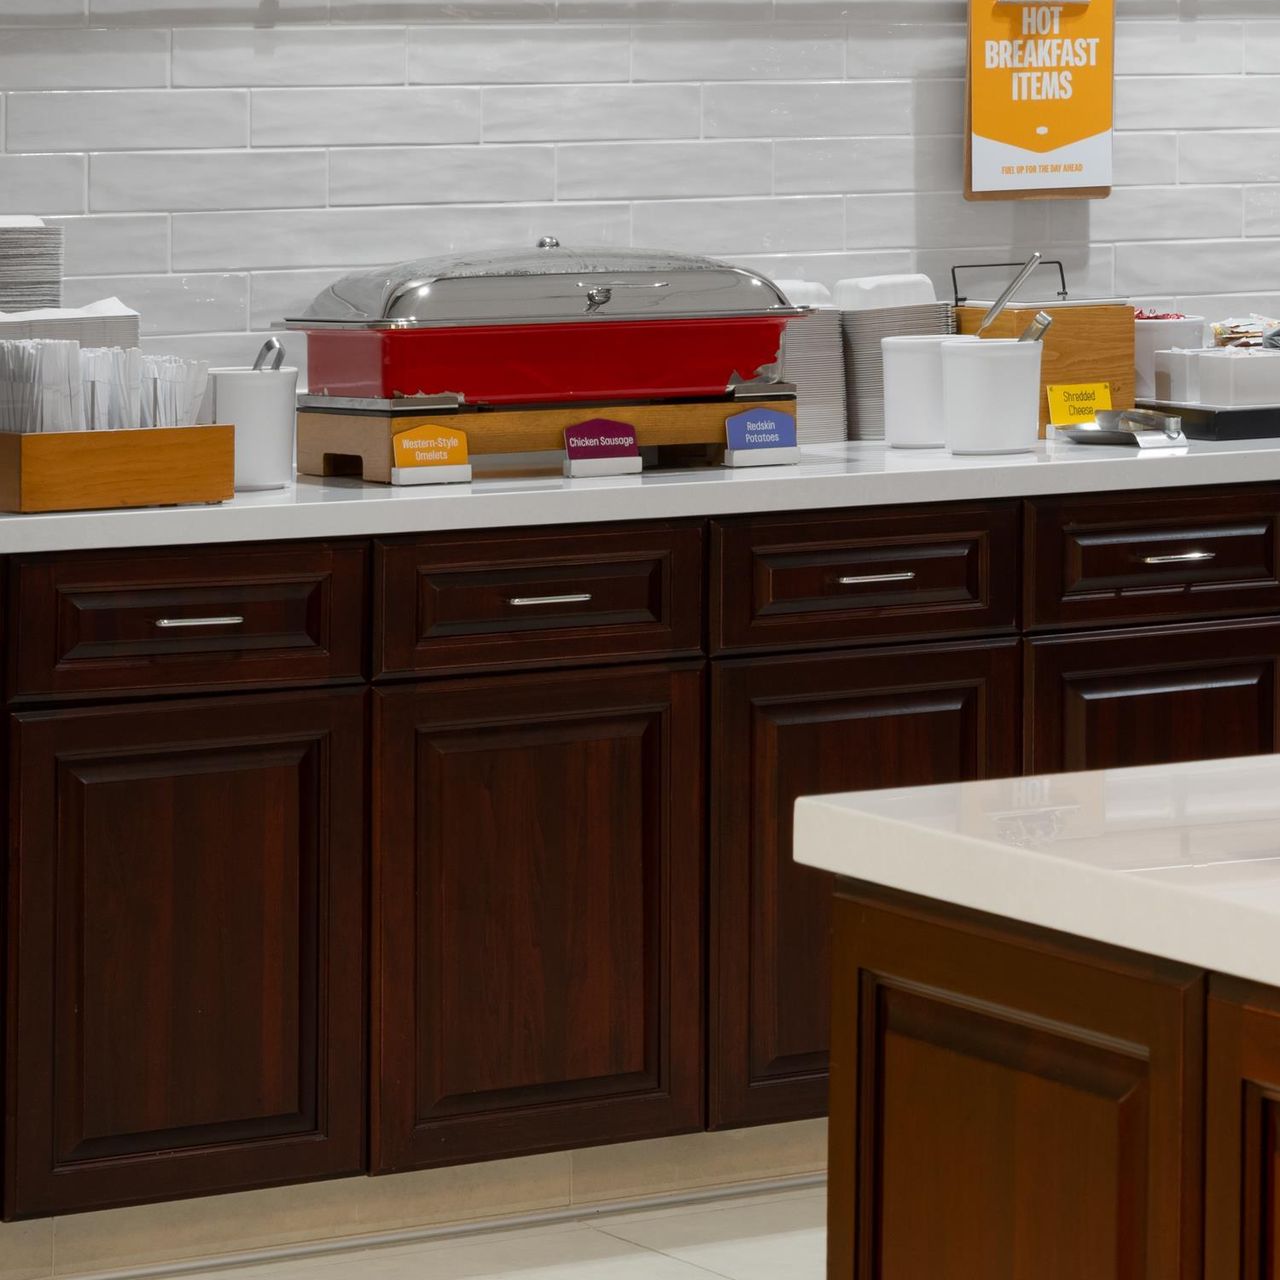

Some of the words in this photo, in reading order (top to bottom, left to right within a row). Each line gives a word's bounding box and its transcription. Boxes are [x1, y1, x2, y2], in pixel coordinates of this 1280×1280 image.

[1022, 6, 1063, 35] HOT
[984, 38, 1100, 69] BREAKFAST
[1011, 70, 1073, 101] ITEMS
[1063, 390, 1096, 402] Shredded
[1068, 404, 1094, 416] Cheese
[747, 420, 776, 431] Redskin
[402, 437, 459, 450] Western-Style
[569, 437, 599, 447] Chicken
[600, 436, 634, 447] Sausage
[745, 433, 779, 443] Potatoes
[415, 451, 448, 461] Omelets
